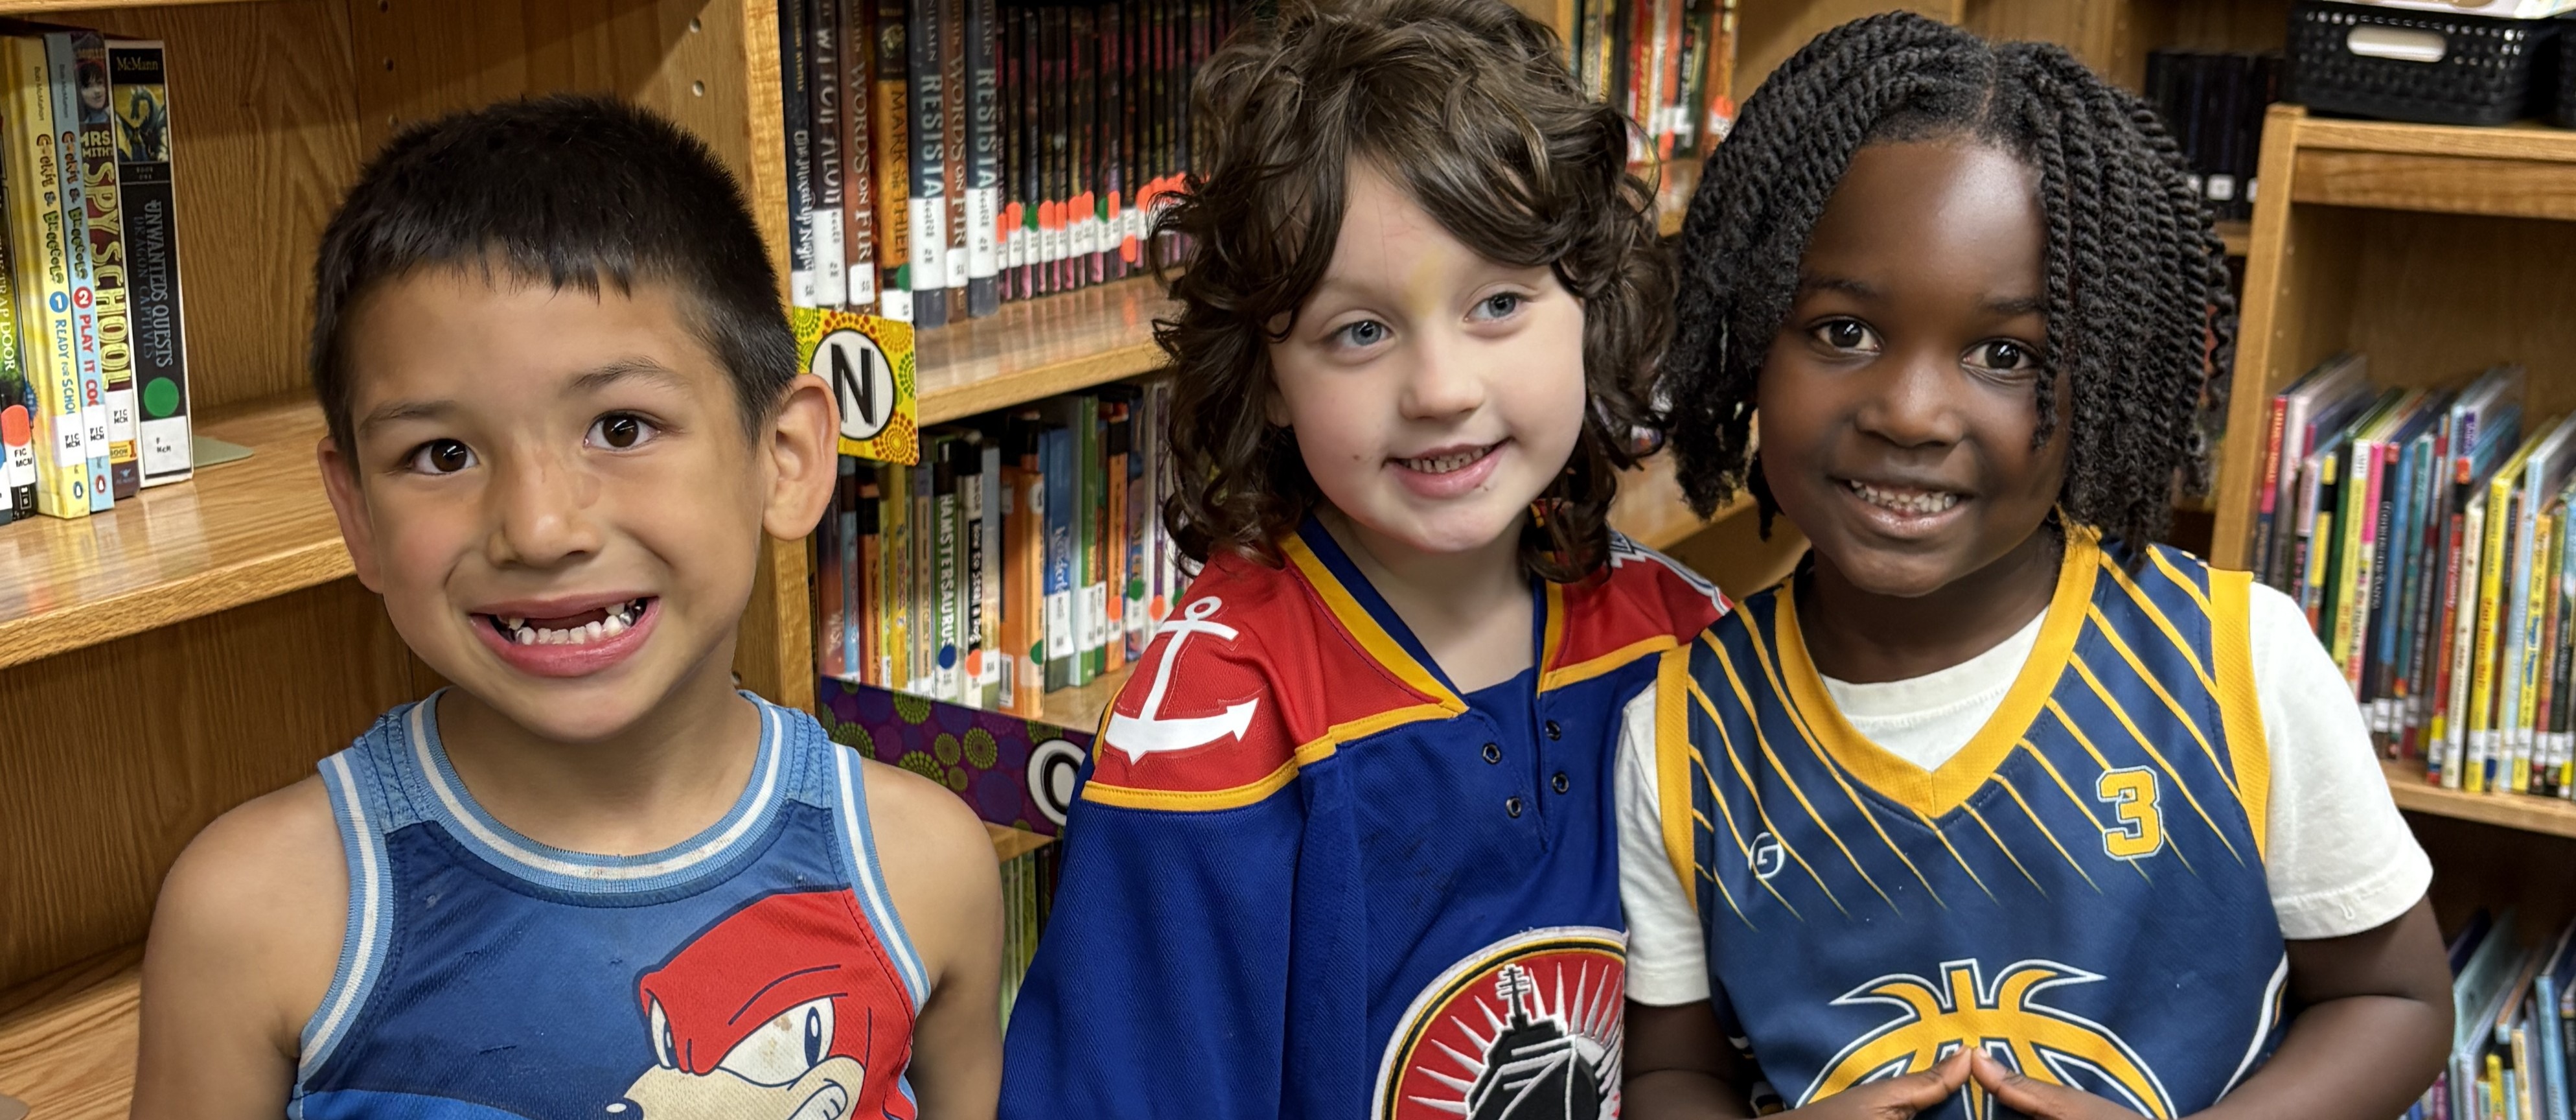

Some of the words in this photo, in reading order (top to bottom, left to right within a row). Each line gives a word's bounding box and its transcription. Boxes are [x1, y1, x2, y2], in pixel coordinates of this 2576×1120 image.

[117, 56, 158, 71] McMann
[851, 61, 869, 174] WORDS
[890, 90, 906, 162] MARK
[949, 54, 965, 161] WORDS
[83, 162, 119, 235] SPY
[858, 177, 869, 205] ON
[955, 165, 965, 191] ON
[133, 216, 149, 278] DRAGON
[144, 199, 168, 302] UNWANTEDS
[893, 197, 908, 259] THIEF
[55, 295, 63, 309] 1
[78, 290, 89, 305] 2
[91, 240, 132, 392] SCHOOL
[139, 285, 155, 359] CAPTIVES
[1, 321, 16, 371] DOOR
[55, 319, 69, 359] READY
[79, 314, 94, 354] PLAY
[152, 304, 173, 368] QUESTS
[84, 359, 96, 373] IT
[831, 343, 877, 427] N
[65, 433, 79, 442] FIC
[113, 409, 128, 418] FIC
[14, 447, 27, 458] FIC
[16, 457, 33, 468] MCM
[938, 494, 956, 649] HAMSTERSAURUS
[2095, 765, 2164, 861] 3
